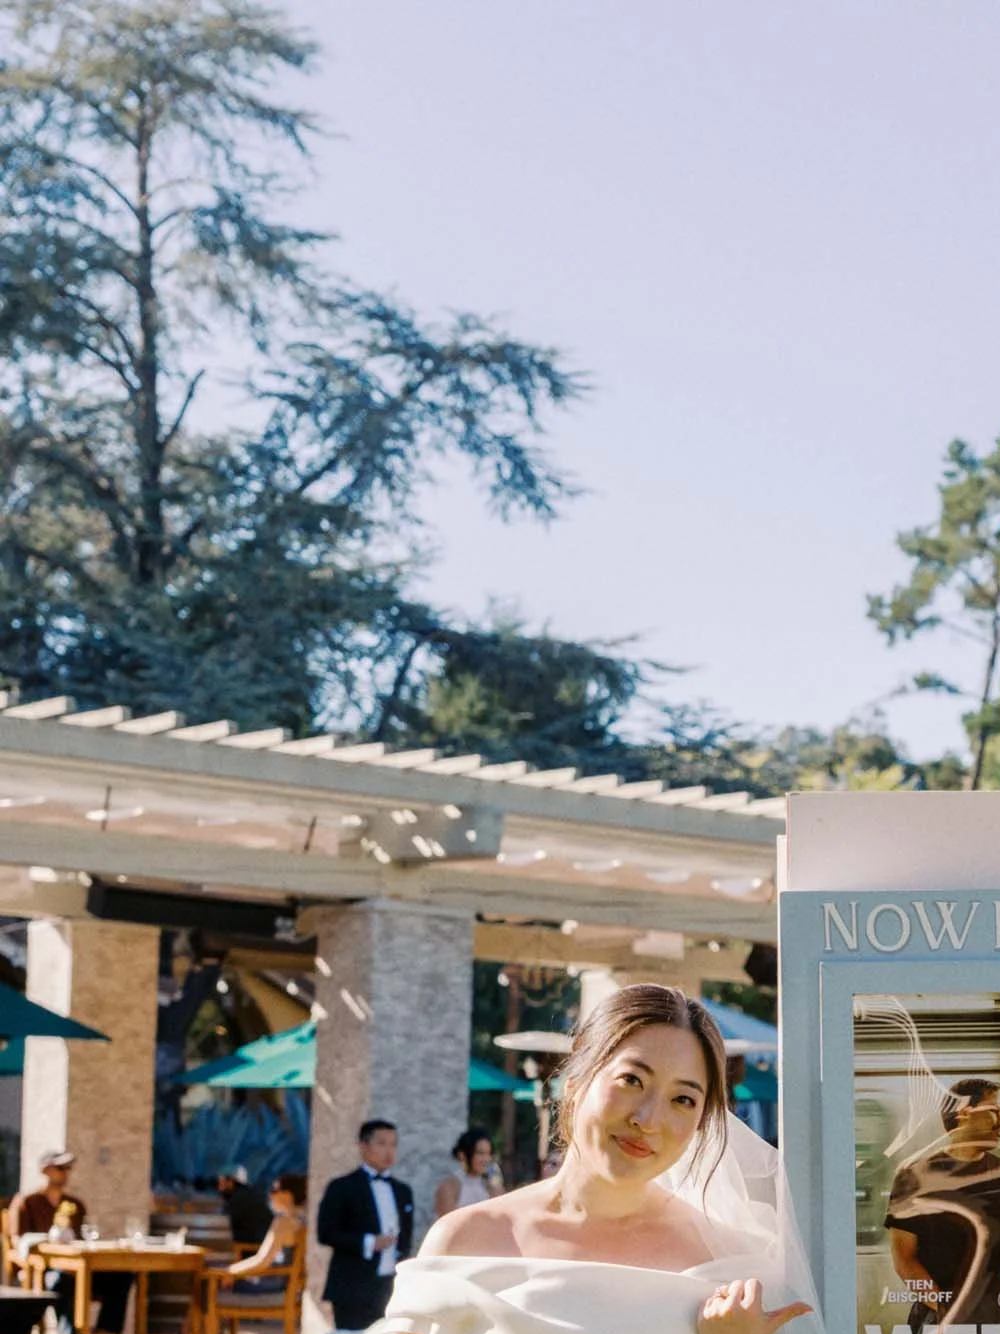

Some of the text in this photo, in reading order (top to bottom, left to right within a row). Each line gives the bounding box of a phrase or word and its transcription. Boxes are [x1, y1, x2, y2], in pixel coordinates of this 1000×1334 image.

[822, 900, 980, 952] NOW
[905, 1279, 933, 1291] TIEN
[888, 1291, 953, 1303] BISCHOFF
